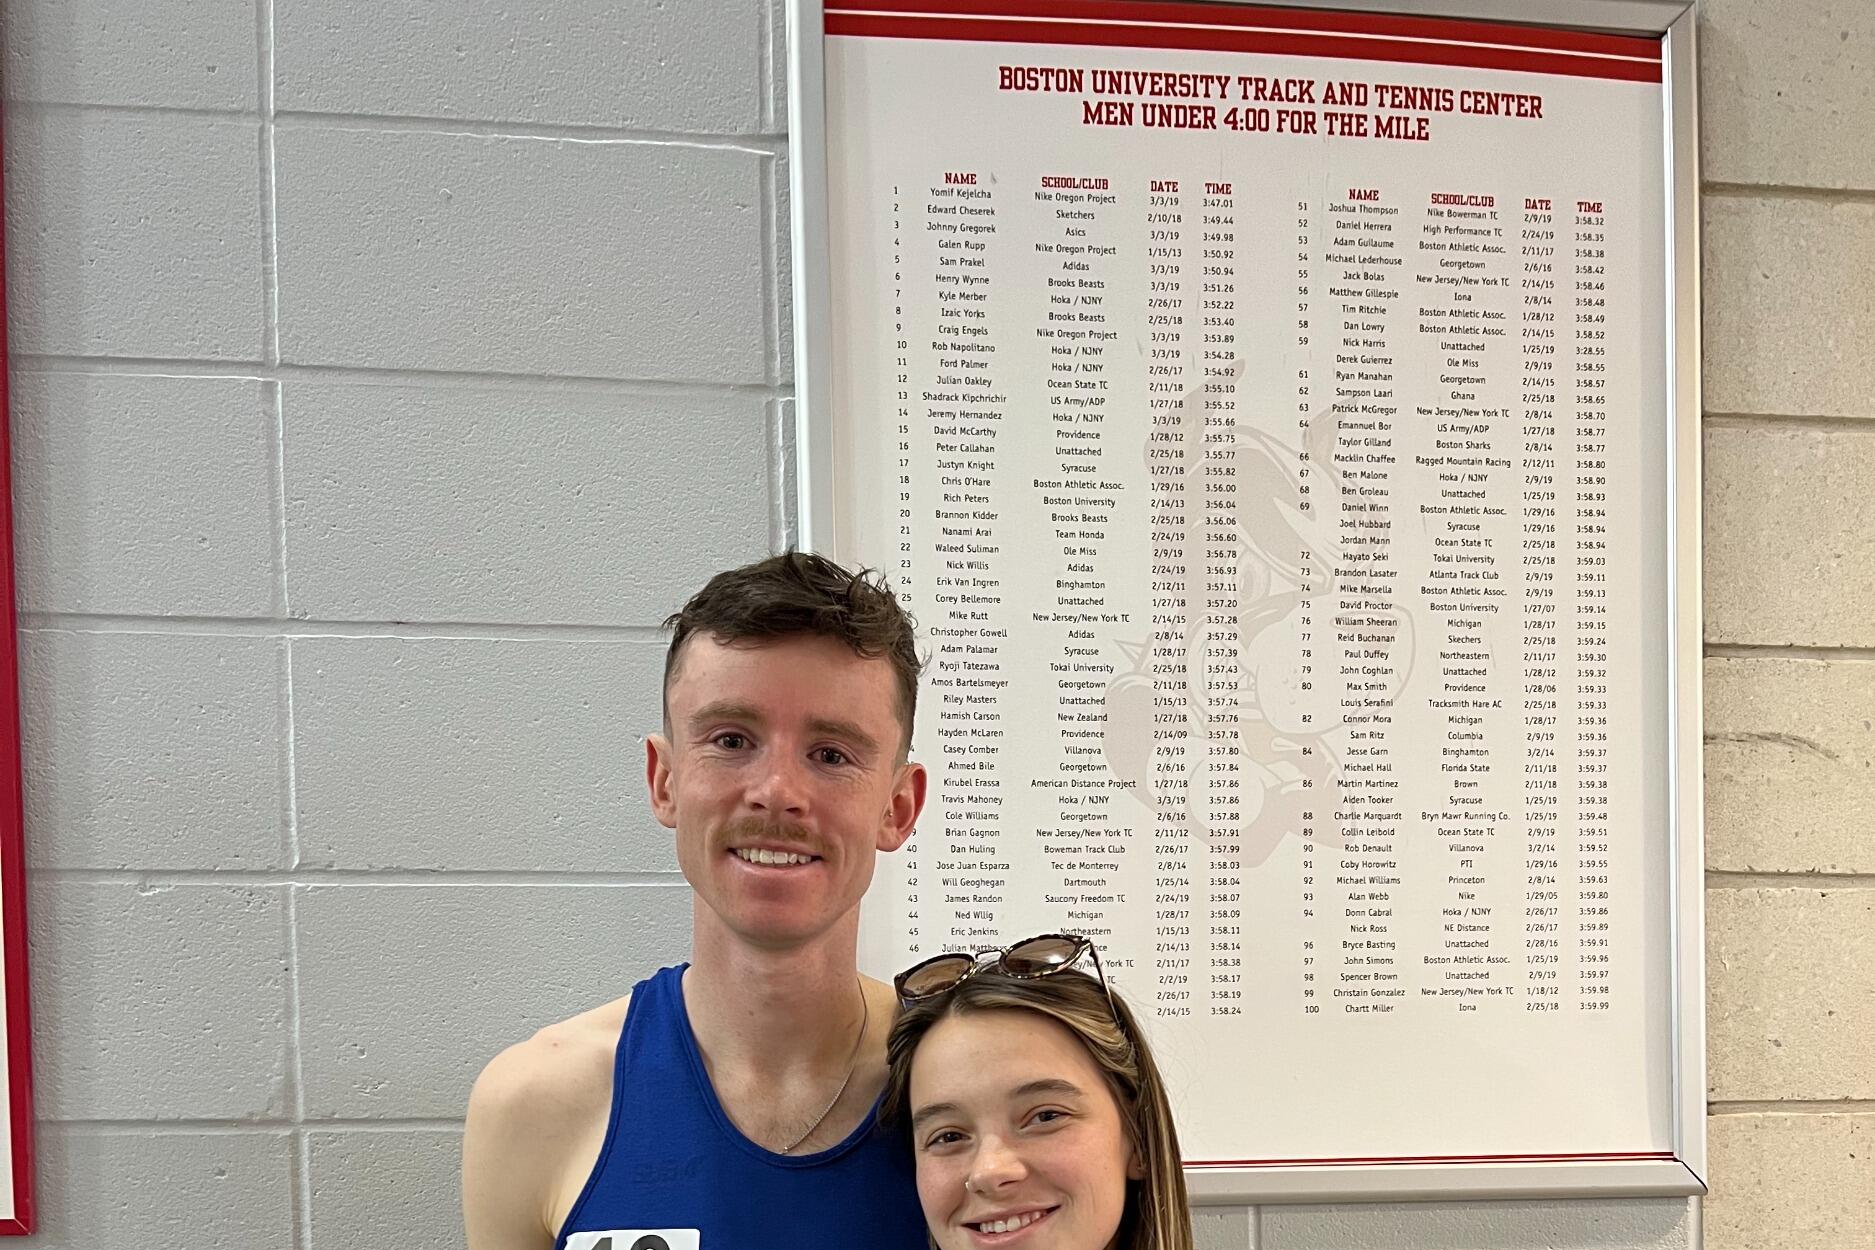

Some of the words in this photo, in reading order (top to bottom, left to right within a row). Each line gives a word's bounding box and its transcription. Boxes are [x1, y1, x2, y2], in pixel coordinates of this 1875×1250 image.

[1000, 67, 1083, 92] BOSTON
[1092, 69, 1231, 99] UNIVERSITY
[1238, 77, 1315, 103] TRACK
[1323, 82, 1367, 106] AND
[1375, 85, 1453, 112] TENNIS
[1460, 91, 1542, 118] CENTER
[1083, 101, 1134, 126] MEN
[1142, 103, 1216, 129] UNDER
[1224, 108, 1269, 132] 4:00
[1277, 110, 1317, 134] FOR
[1324, 112, 1367, 137] THE
[1375, 115, 1429, 140] MILE
[945, 173, 976, 184] NAME
[1042, 177, 1108, 189] SCHOOL/CLUB
[1151, 181, 1178, 192] DATE
[1205, 183, 1231, 194] TIME
[930, 187, 954, 197] Yomif
[956, 188, 992, 201] Kejelcha
[1034, 191, 1053, 201] Nike
[1055, 192, 1085, 204] Oregon
[1087, 193, 1116, 205] Project
[1150, 195, 1179, 208] 3/3/19
[1202, 198, 1233, 209] 3:47.01
[1349, 189, 1378, 201] NAME
[1432, 193, 1494, 207] SCHOOL/CLUB
[1525, 199, 1551, 210] DATE
[1577, 202, 1602, 213] TIME
[1328, 202, 1357, 213] Joshua
[1359, 204, 1399, 216] Thompson
[1427, 207, 1445, 218] Nike
[1446, 208, 1487, 220] Bowerman
[1524, 213, 1552, 224] 2/9/19
[1575, 215, 1605, 226] 3:58.32
[939, 256, 957, 266] Sam
[959, 257, 985, 268] Prakel
[1062, 260, 1090, 271] Adidas
[1150, 264, 1180, 276] 3/3/19
[1203, 266, 1234, 276] 3:50.94
[1343, 321, 1359, 331] Dan
[1361, 321, 1385, 334] Lowry
[1419, 323, 1447, 334] Boston
[1448, 325, 1480, 335] Athletic
[1481, 326, 1507, 336] Assoc.
[1522, 327, 1555, 339] 2/14/15
[936, 375, 962, 385] Julian
[964, 376, 993, 388] Oakley
[1047, 378, 1073, 389] Ocean
[1074, 379, 1097, 390] State
[1149, 382, 1184, 393] 2/11/18
[1204, 383, 1236, 394] 3:55.10
[1335, 387, 1371, 399] Sampson
[1450, 390, 1476, 401] Ghana
[1522, 393, 1555, 405] 2/25/18
[1576, 395, 1606, 405] 3:58.65
[933, 425, 957, 436] David
[959, 426, 997, 439] McCarthy
[1056, 429, 1101, 440] Providence
[1150, 432, 1184, 443] 1/28/12
[1204, 433, 1236, 444] 3:55.75
[935, 509, 970, 520] Brannon
[972, 511, 999, 521] Kidder
[1051, 512, 1079, 522] Brooks
[1081, 513, 1108, 523] Beasts
[1151, 514, 1185, 526] 2/25/18
[1342, 551, 1371, 563] Hayato
[1372, 552, 1389, 562] Seki
[1455, 554, 1495, 566] University
[1523, 555, 1556, 566] 2/25/18
[1576, 557, 1606, 566] 3:59.03
[1337, 633, 1355, 642] Reid
[1357, 633, 1396, 643] Buchanan
[1447, 634, 1482, 644] Skechers
[1523, 636, 1556, 647] 2/25/18
[1577, 637, 1606, 646] 3:59.24
[943, 694, 964, 706] Riley
[966, 694, 997, 704] Masters
[1059, 696, 1106, 706] Unattached
[1153, 696, 1187, 708] 1/15/13
[1207, 697, 1239, 707] 3:57.74
[1342, 714, 1371, 724] Connor
[1372, 714, 1392, 724] Mora
[1448, 715, 1483, 726] Michigan
[1524, 716, 1557, 727] 1/28/17
[1577, 716, 1607, 726] 3:59.36
[947, 761, 976, 771] Ahmed
[978, 761, 995, 771] Bile
[1059, 762, 1107, 774] Georgetown
[1156, 762, 1186, 773] 2/6/16
[1208, 763, 1239, 772] 3:57.84
[1344, 843, 1360, 853] Rob
[1362, 843, 1393, 853] Denault
[1448, 843, 1485, 852] Villanova
[1527, 843, 1556, 854] 3/2/14
[1578, 843, 1608, 852] 3:59.52
[941, 877, 958, 887] Will
[959, 877, 1005, 889] Geoghegan
[1064, 877, 1107, 887] Dartmouth
[1155, 877, 1190, 888] 1/25/14
[1209, 877, 1241, 886] 3:58.04
[1348, 892, 1366, 901] Alan
[1368, 891, 1390, 901] Webb
[1458, 891, 1476, 901] Nike
[1525, 891, 1558, 902] 1/29/05
[1579, 891, 1609, 900] 3:59.80
[1157, 1007, 1191, 1018] 2/14/15
[1211, 1006, 1242, 1016] 3:58.24
[1304, 1005, 1320, 1014] 100
[1371, 1004, 1394, 1013] Miller
[1458, 1002, 1477, 1012] Iona
[1526, 1002, 1559, 1013] 2/25/18
[1579, 1001, 1610, 1010] 3:59.99
